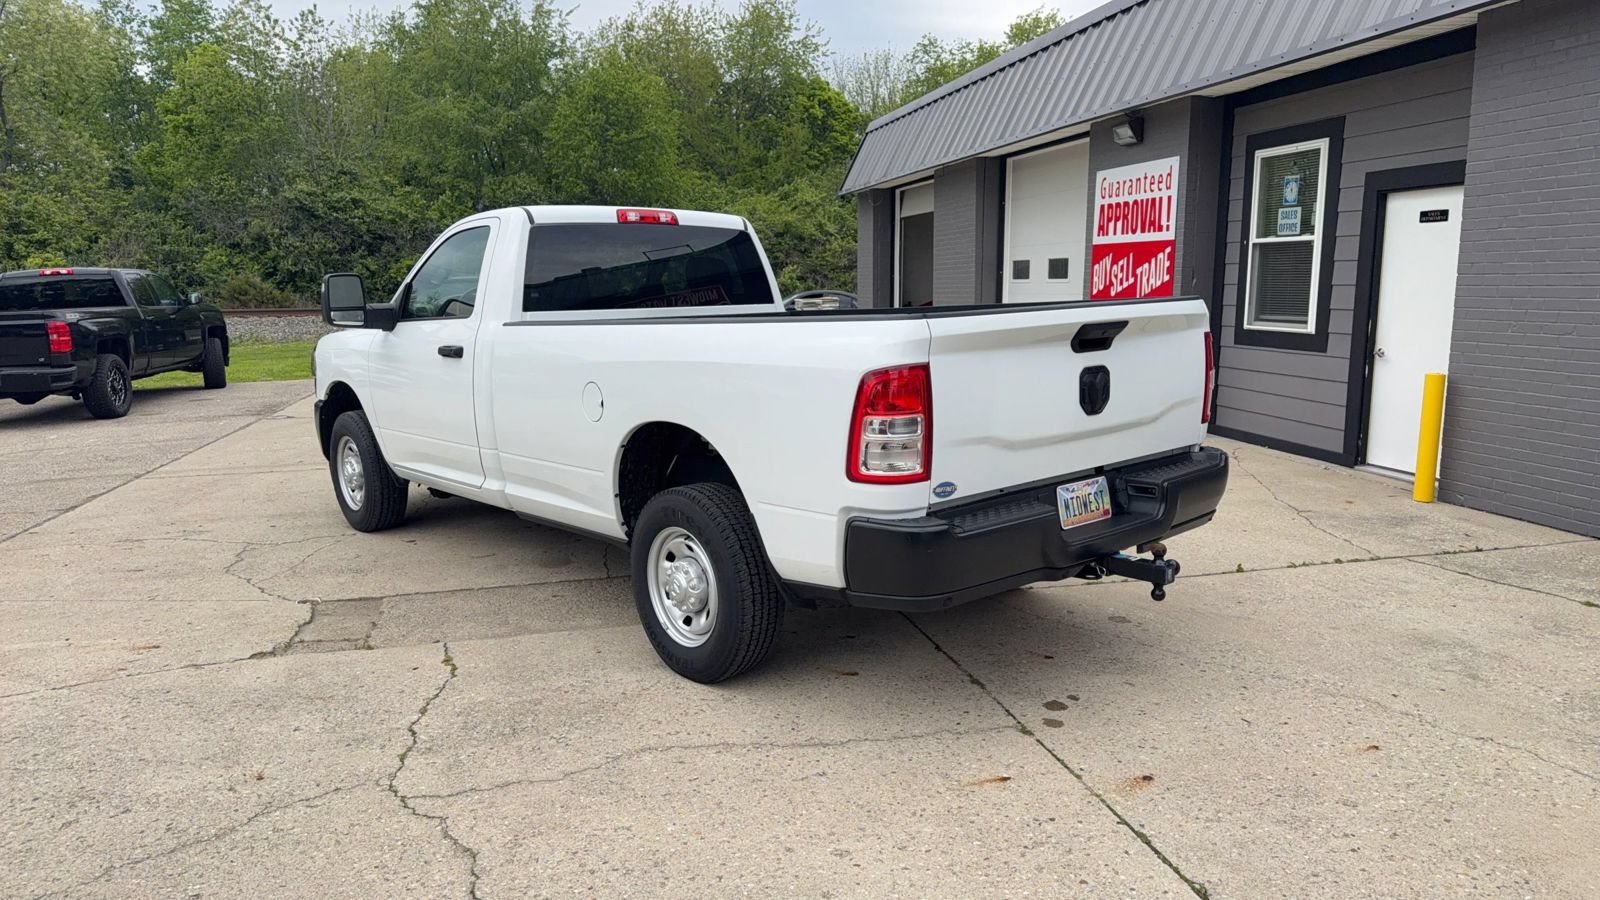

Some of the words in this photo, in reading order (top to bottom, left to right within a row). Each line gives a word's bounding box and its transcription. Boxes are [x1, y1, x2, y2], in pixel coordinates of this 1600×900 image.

[1100, 165, 1173, 199] Guaranteed
[1097, 195, 1172, 237] APPROVAL!
[1278, 222, 1298, 233] OFFICE
[1281, 209, 1298, 220] SALES
[1092, 253, 1113, 295] BUY
[1110, 252, 1135, 297] SELL
[1136, 246, 1172, 298] TRADE
[1063, 489, 1105, 519] MIDWEST
